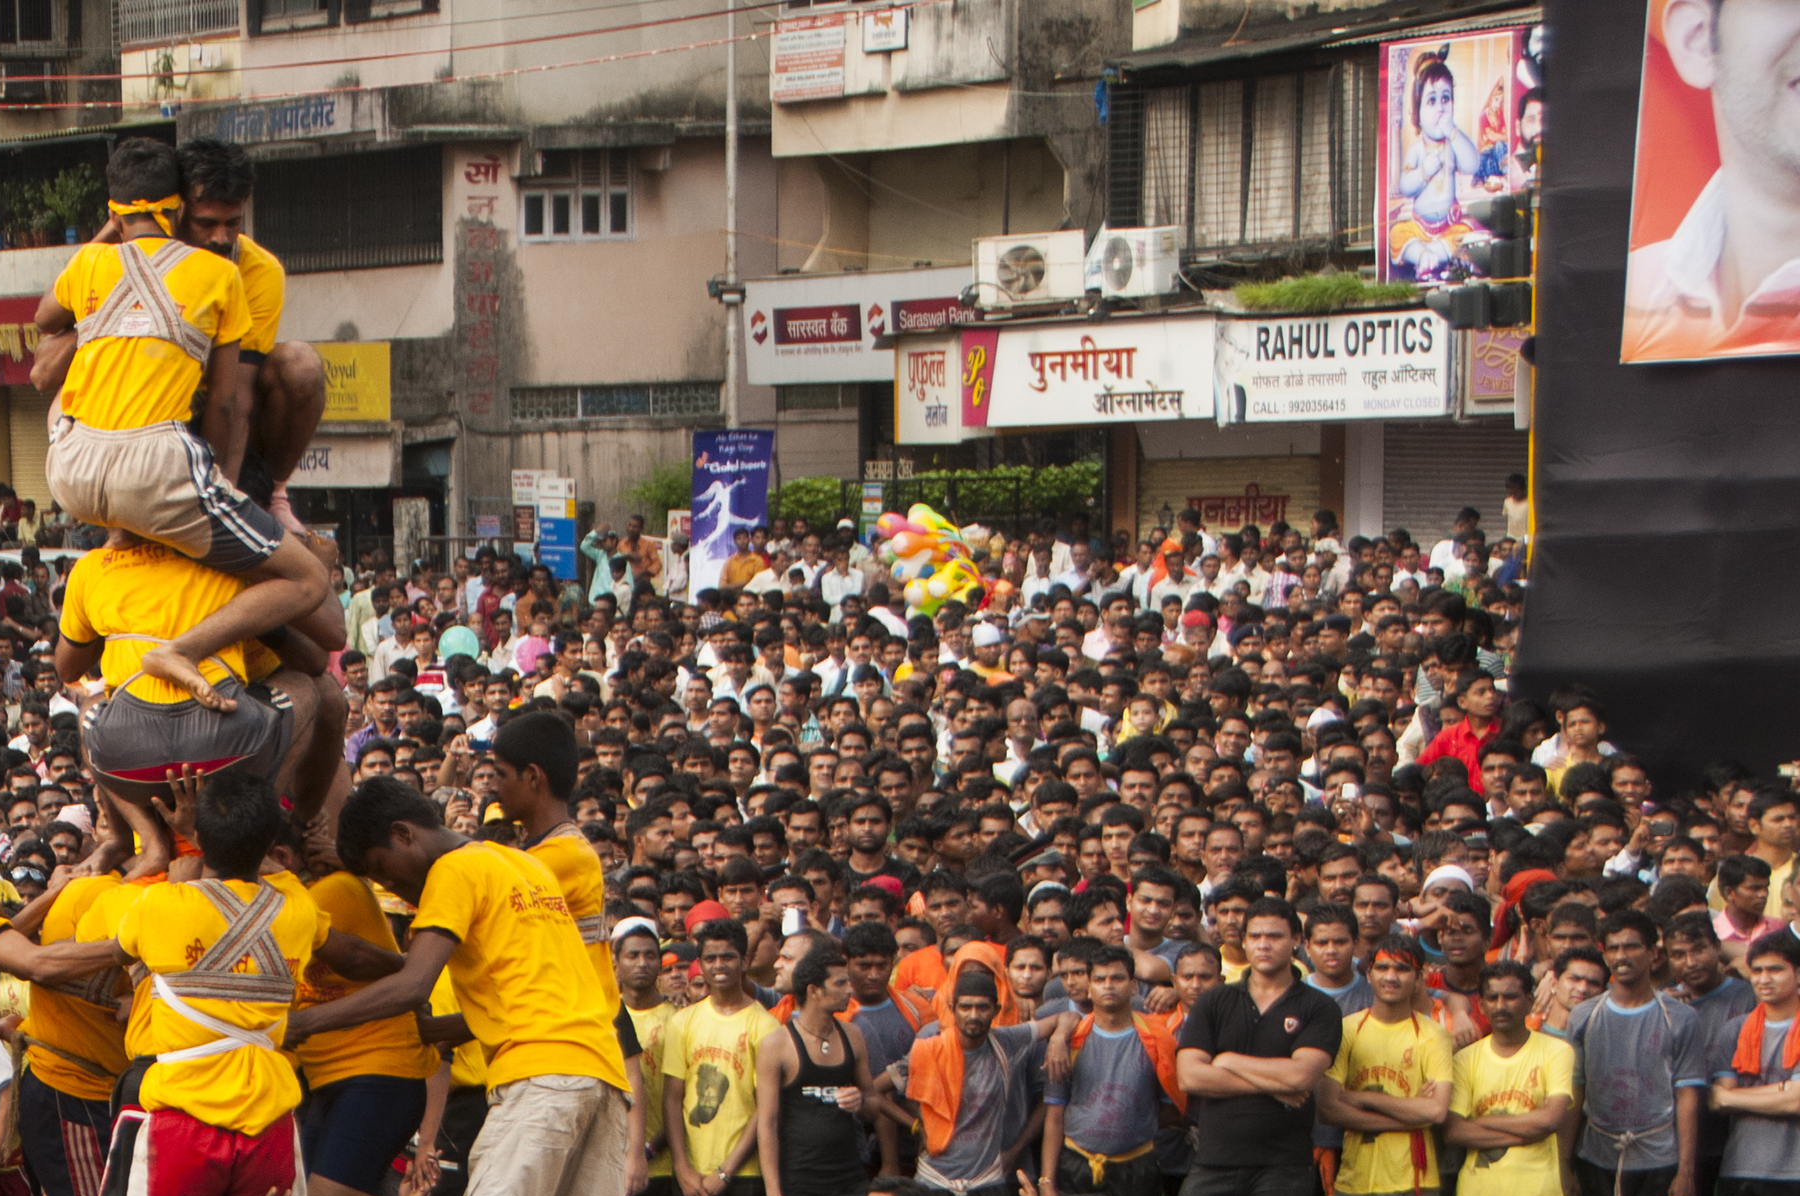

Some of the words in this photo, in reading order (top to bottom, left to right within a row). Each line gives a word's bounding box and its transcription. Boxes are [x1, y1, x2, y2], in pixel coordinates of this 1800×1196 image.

[786, 318, 827, 340] सारस्वत
[829, 310, 848, 337] बँक
[899, 309, 946, 329] Saraswat
[948, 305, 976, 325] Bank
[1255, 322, 1335, 361] RAHUL
[1343, 316, 1434, 358] OPTICS
[907, 350, 947, 403] प्रफुल्ल
[1029, 335, 1138, 393] पुनमीया
[1252, 372, 1279, 389] मोफत
[1283, 369, 1304, 388] डोळे
[1306, 367, 1347, 387] तपासणी
[1361, 366, 1387, 390] राहुल
[326, 392, 358, 405] TTONS
[1252, 401, 1280, 415] CALL
[1287, 399, 1346, 414] 9920356415
[1362, 398, 1401, 411] MONDAY
[1403, 396, 1439, 409] CLOSED
